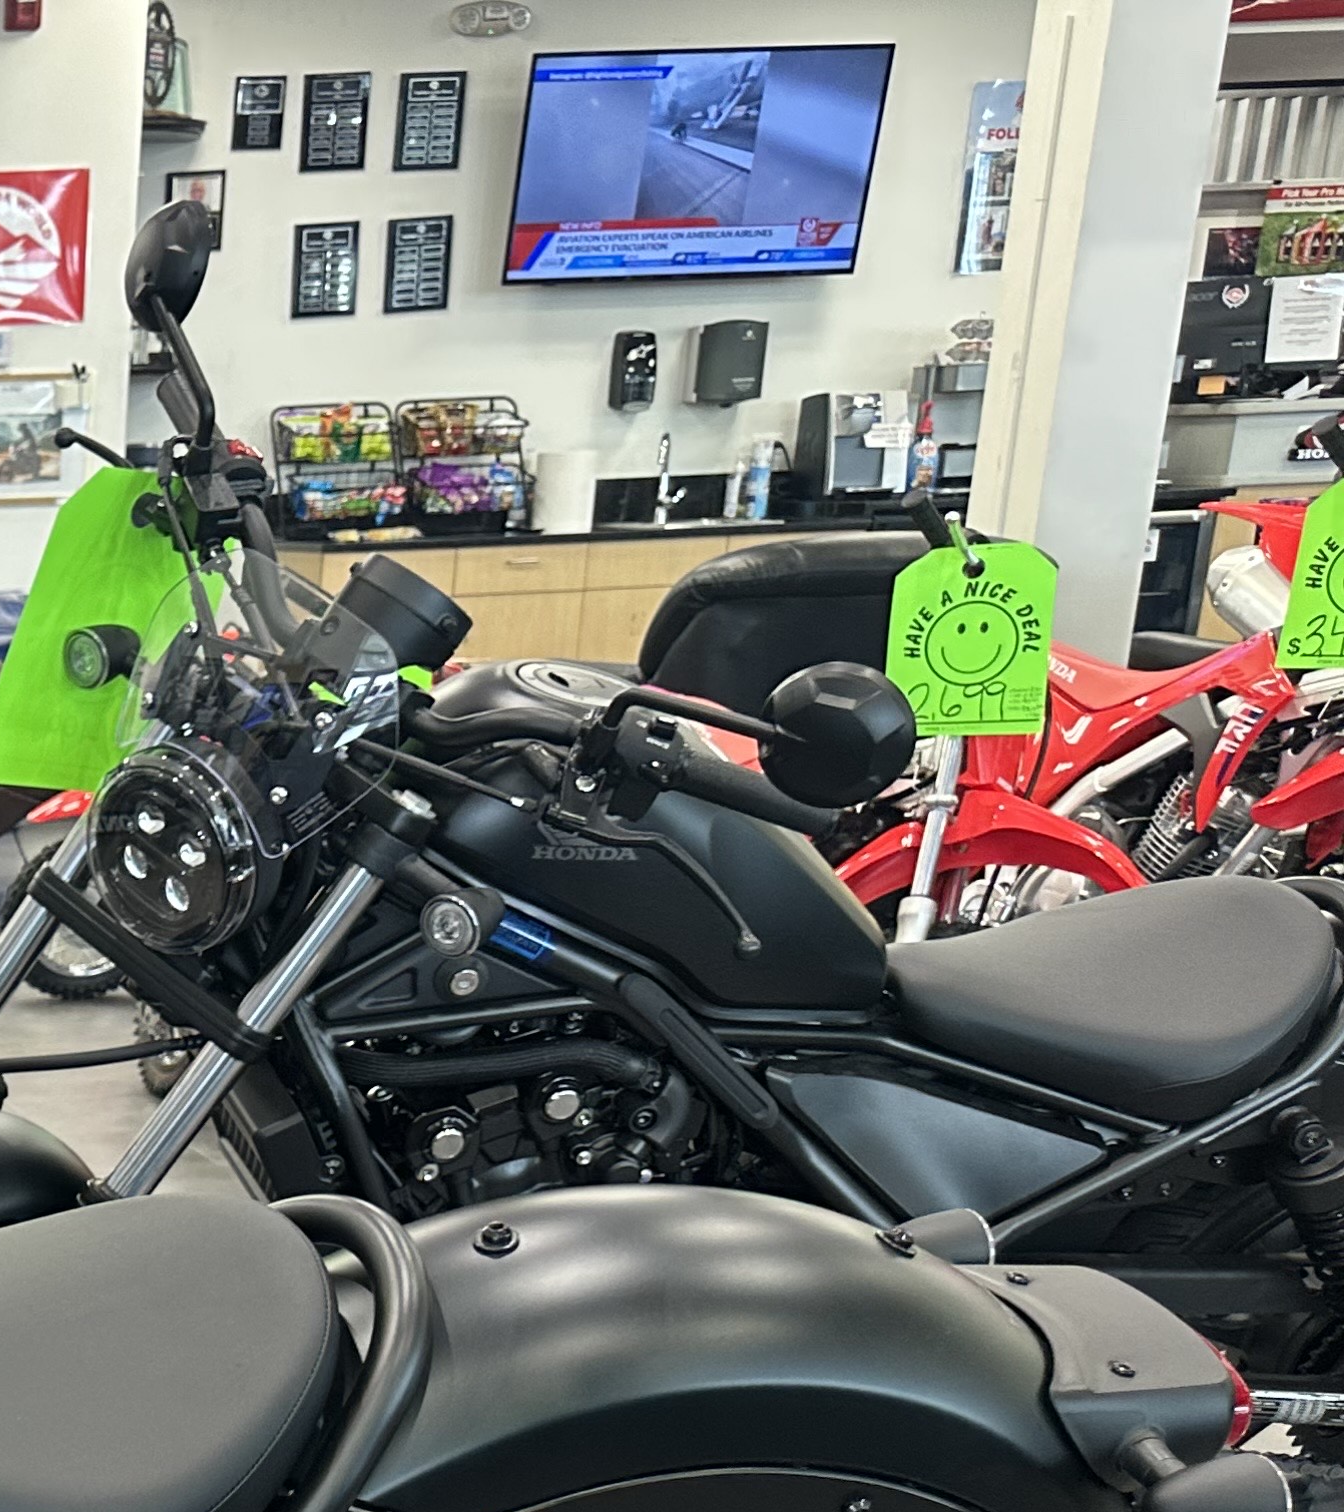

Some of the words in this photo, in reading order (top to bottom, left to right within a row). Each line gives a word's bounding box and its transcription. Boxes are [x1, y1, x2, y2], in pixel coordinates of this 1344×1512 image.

[1282, 188, 1300, 198] Pick
[1302, 188, 1320, 197] Your
[1321, 187, 1335, 196] Pro
[16, 196, 54, 241] WRLD
[558, 234, 600, 244] AVIATION
[602, 233, 639, 242] EXPERTS
[641, 232, 669, 241] SPEAK
[670, 231, 684, 240] ON
[685, 230, 733, 240] AMERICAN
[734, 228, 773, 238] AIRLINES
[556, 245, 610, 255] EMERGENCY
[611, 242, 668, 252] EVACUATION
[1305, 536, 1339, 589] HAVE
[904, 607, 934, 658] HAVE
[941, 590, 953, 607] A
[964, 581, 1017, 603] NICE
[1016, 604, 1041, 653] DEAL
[1049, 654, 1077, 685] NDA
[531, 846, 639, 861] HONDA
